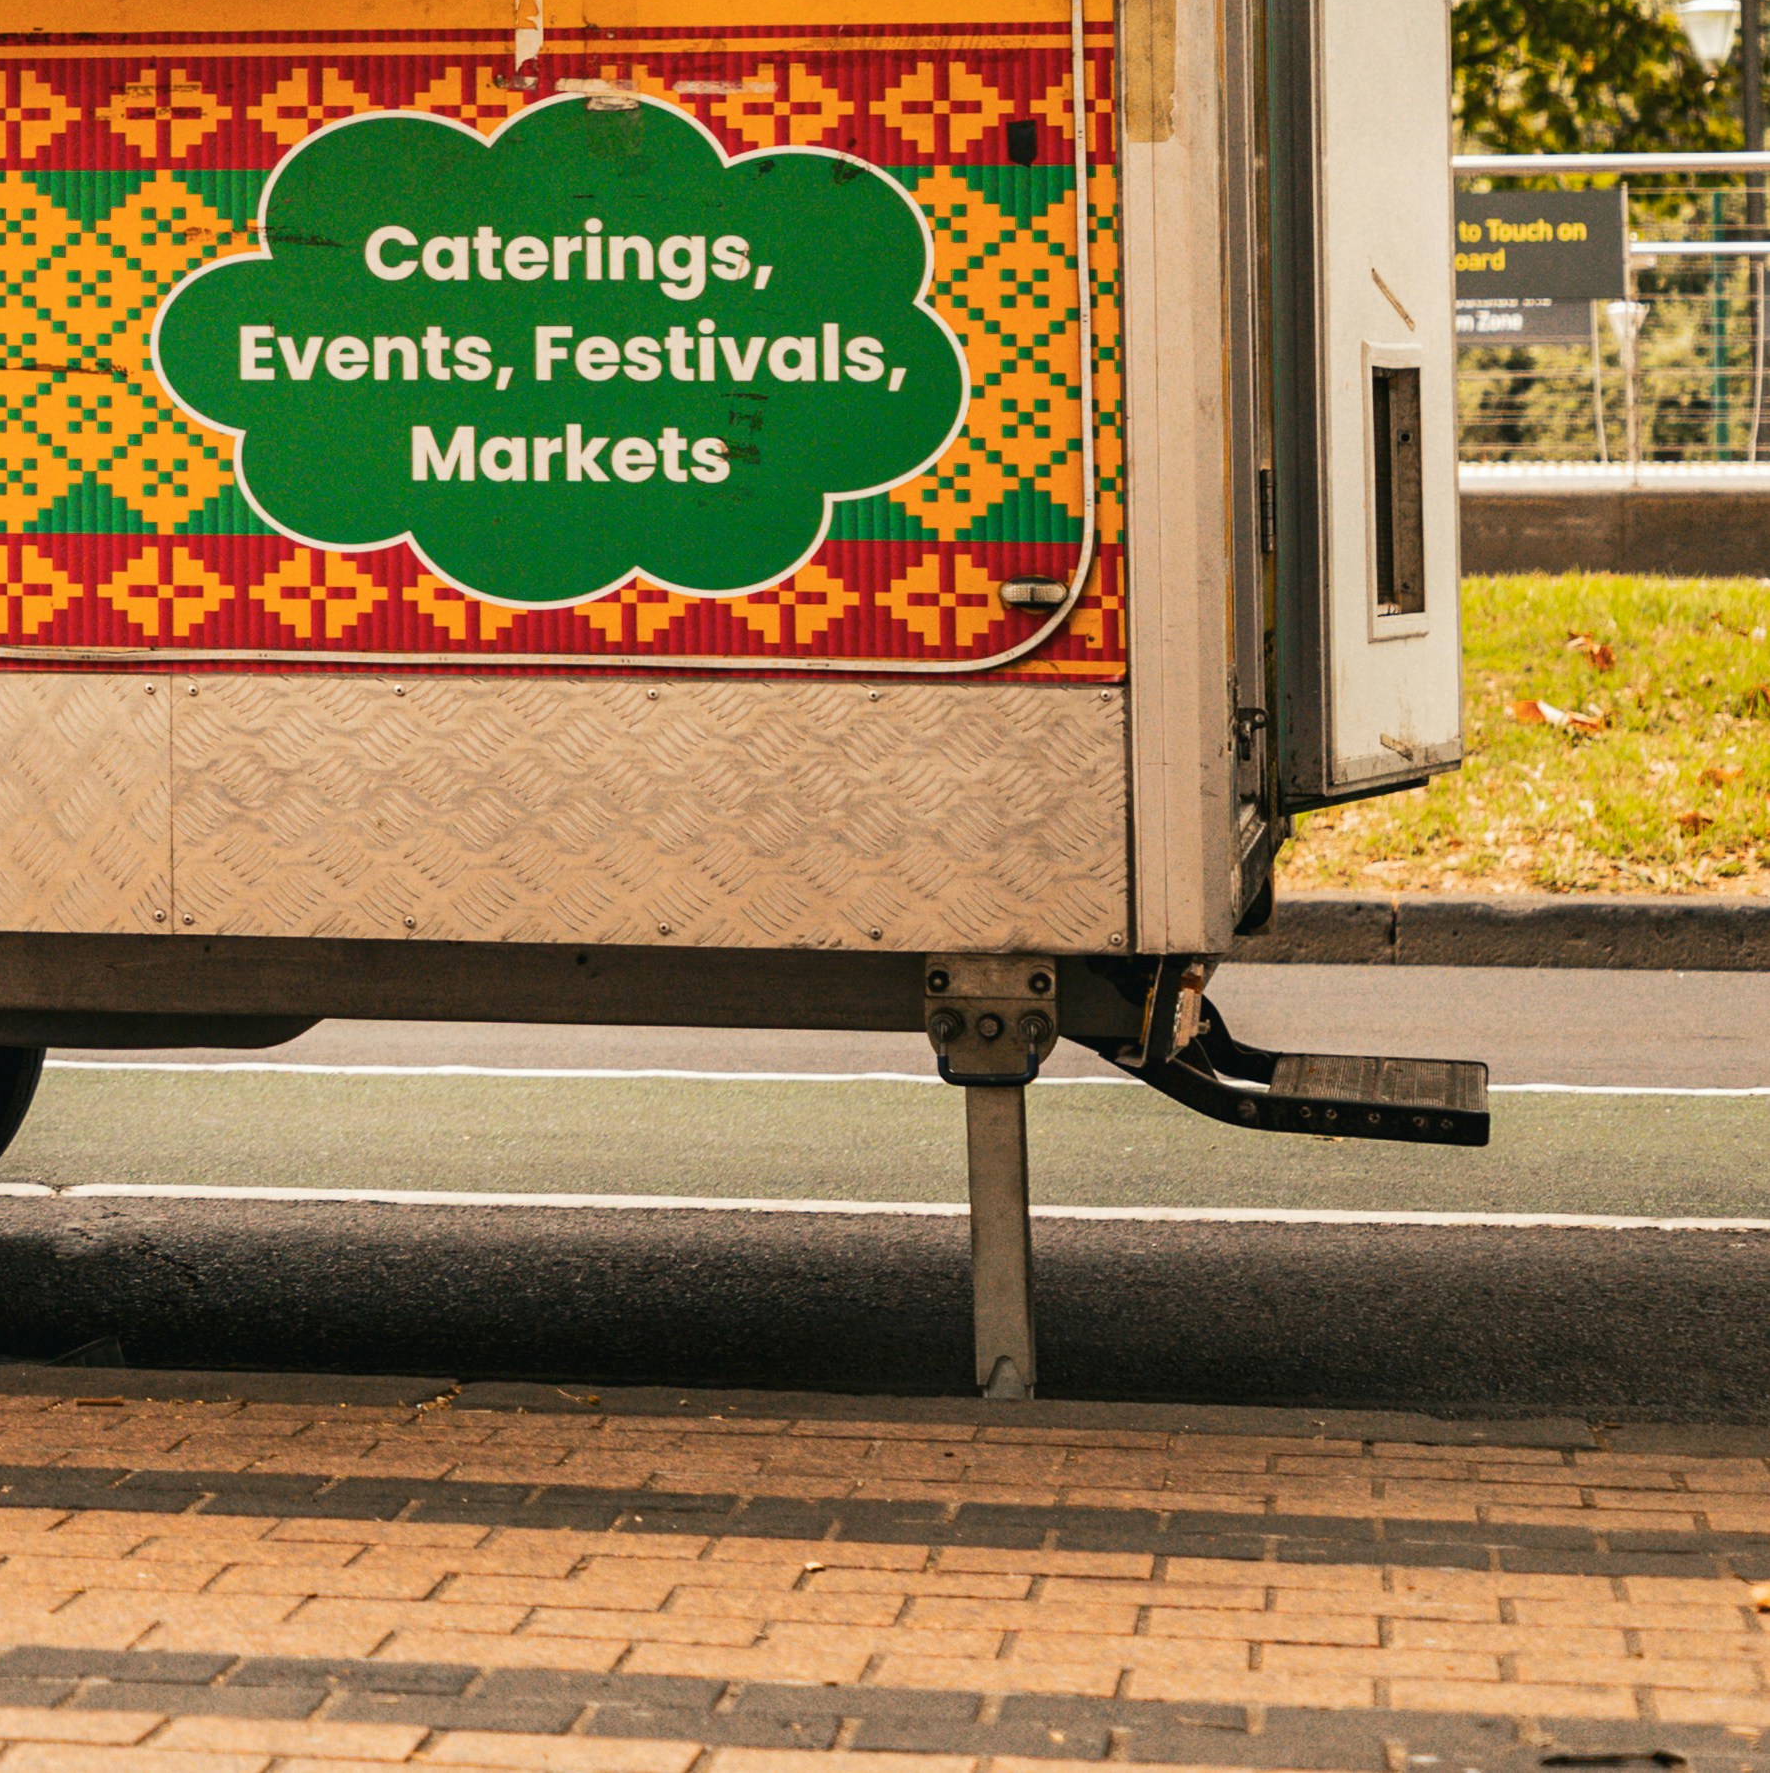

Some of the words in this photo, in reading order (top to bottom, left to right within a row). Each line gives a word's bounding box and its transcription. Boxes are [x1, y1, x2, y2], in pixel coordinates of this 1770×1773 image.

[363, 216, 773, 302] Caterings,
[1458, 219, 1482, 243] to
[1485, 218, 1554, 243] Touch
[1557, 222, 1588, 242] on
[239, 324, 514, 391] Events,
[533, 317, 907, 393] Festivals,
[410, 422, 732, 485] Markets
